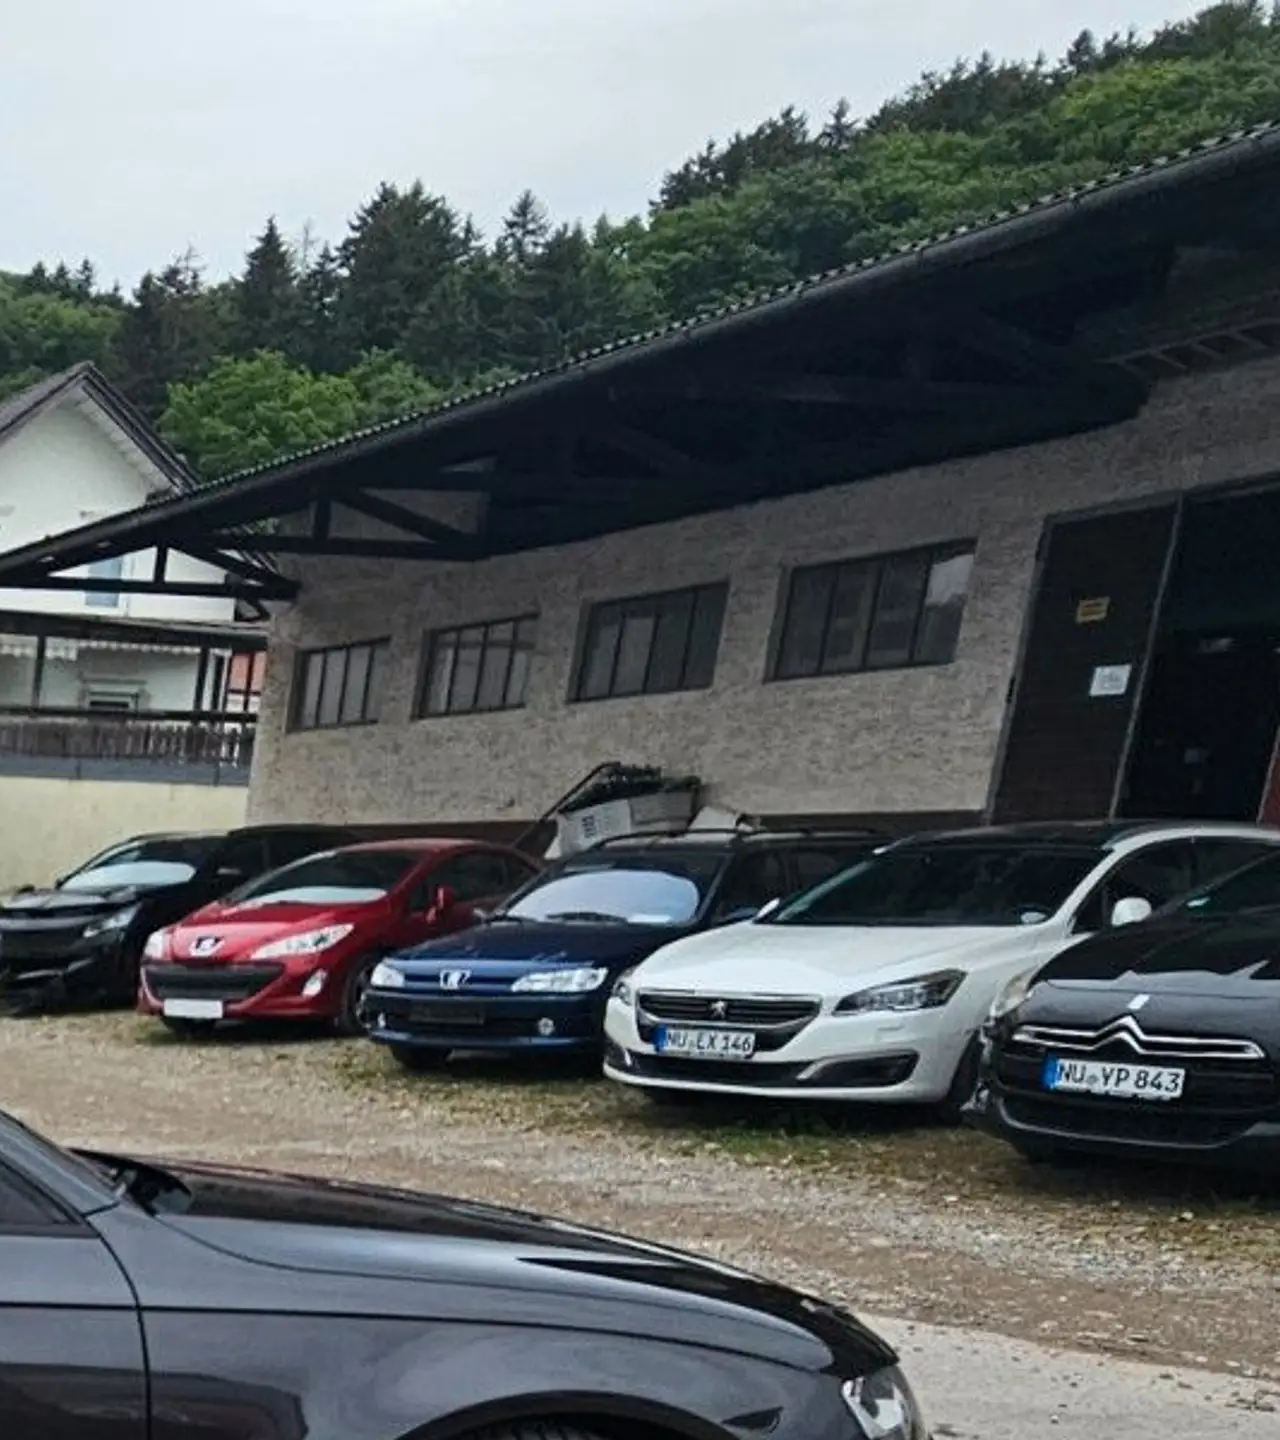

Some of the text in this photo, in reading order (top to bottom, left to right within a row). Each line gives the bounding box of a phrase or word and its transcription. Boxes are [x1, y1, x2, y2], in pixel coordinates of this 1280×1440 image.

[667, 1031, 688, 1048] NU
[1059, 1062, 1181, 1093] NU YP 843
